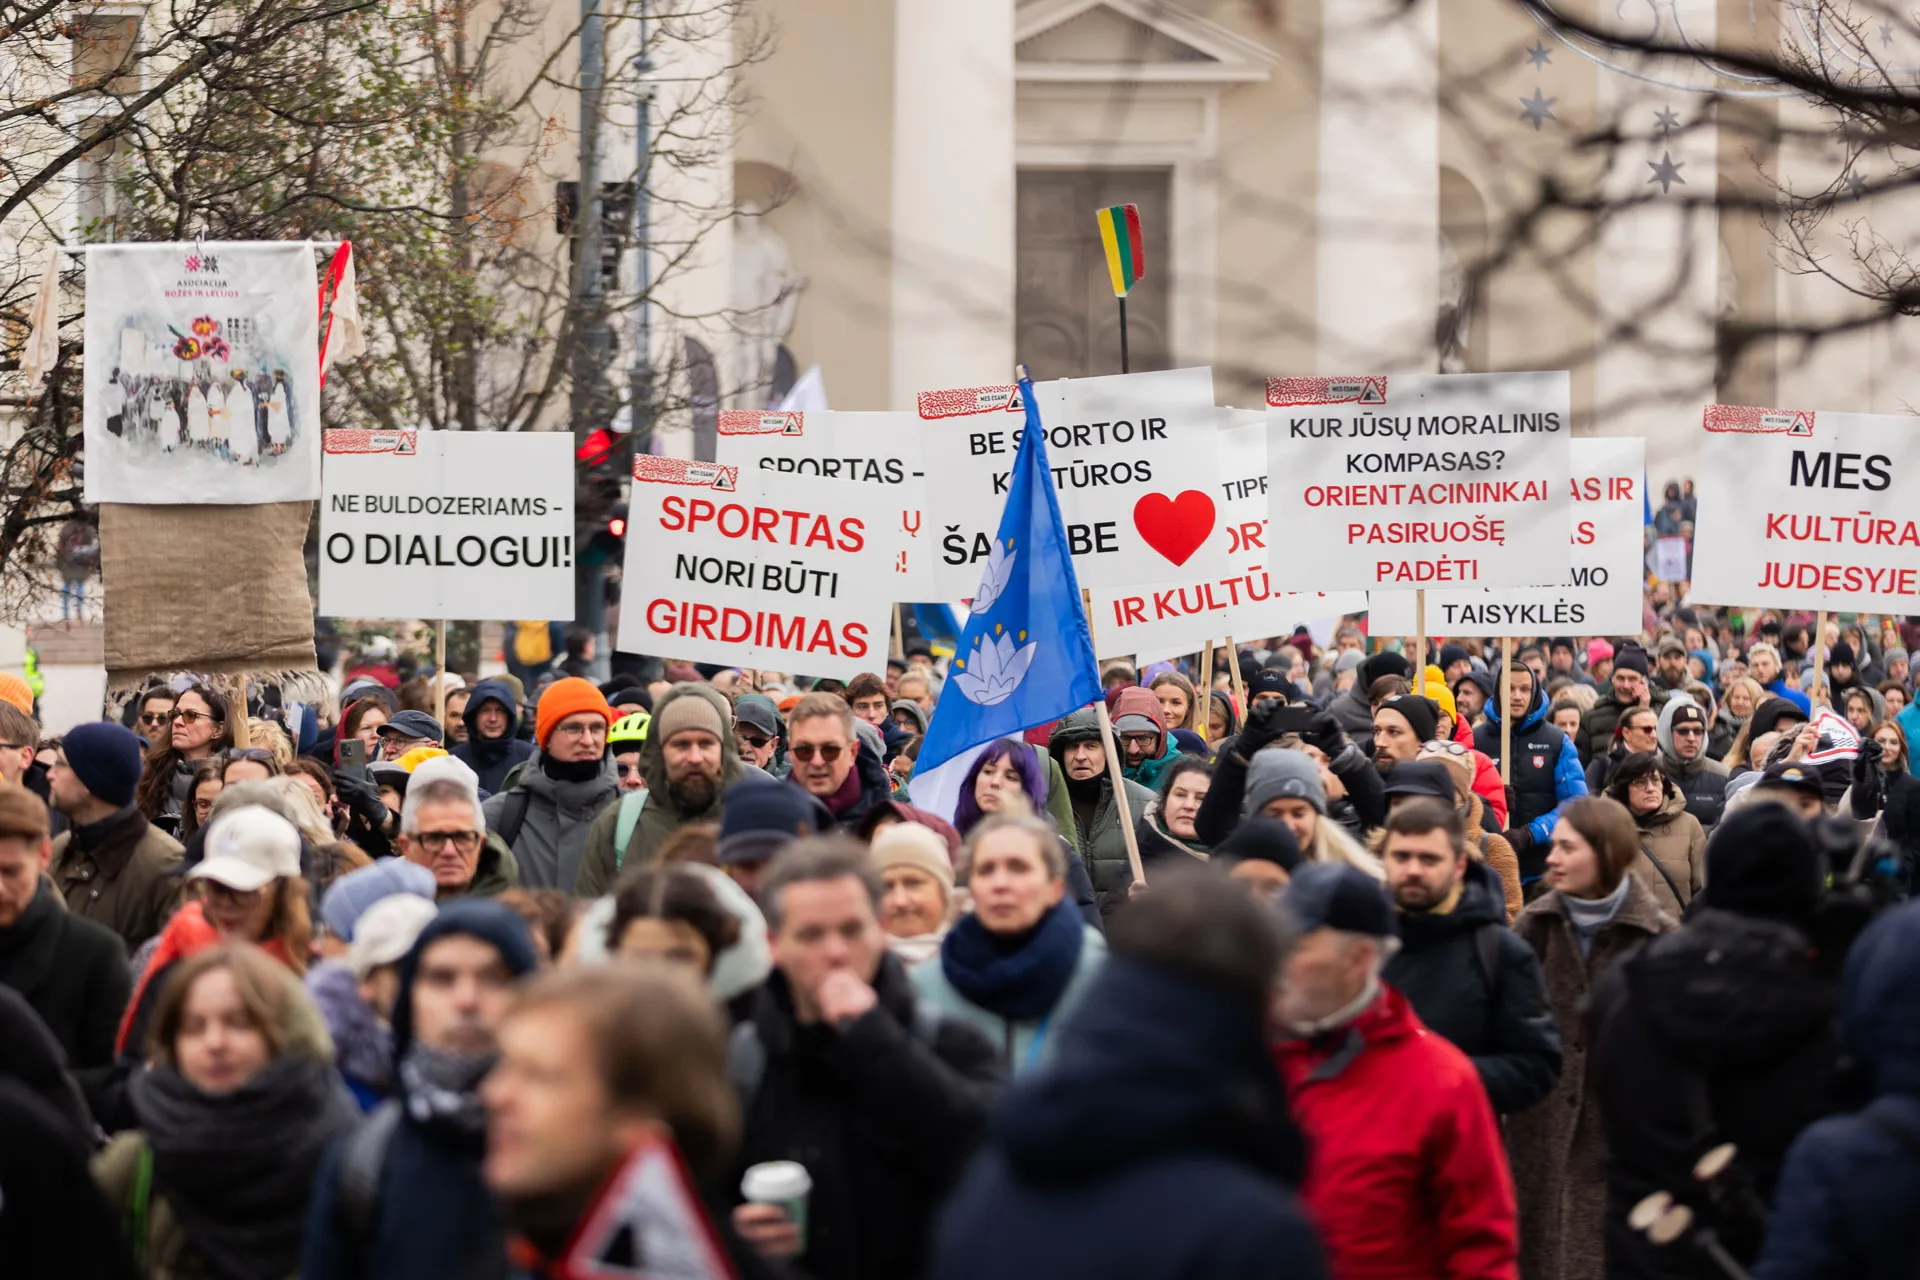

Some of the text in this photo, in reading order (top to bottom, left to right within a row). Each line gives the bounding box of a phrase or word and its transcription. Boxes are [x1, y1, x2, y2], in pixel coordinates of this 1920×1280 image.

[176, 279, 228, 287] ASOCIACIJA
[969, 431, 1006, 456] BE
[1141, 417, 1168, 441] IR
[1290, 412, 1561, 441] KUR JŪSŲ MORALINIS
[992, 459, 1152, 495] KTŪROS
[1346, 450, 1506, 474] KOMPASAS?
[1790, 450, 1892, 491] MES
[331, 494, 360, 513] NE
[364, 495, 548, 516] BULDOZERIAMS
[1303, 480, 1548, 507] ORIENTACININKAI
[1608, 477, 1634, 501] IR
[659, 495, 865, 553] SPORTAS
[1347, 514, 1506, 546] PASIRUOŠĘ
[1766, 510, 1920, 547] KULTŪRA
[326, 532, 572, 568] O DIALOGUI!
[674, 553, 839, 599] NORI BŪTI
[1376, 554, 1479, 582] PADĖTI
[1757, 562, 1920, 596] JUDESYJE
[1112, 596, 1149, 628] IR
[1441, 598, 1586, 624] TAISYKLĖS
[645, 598, 869, 659] GIRDIMAS
